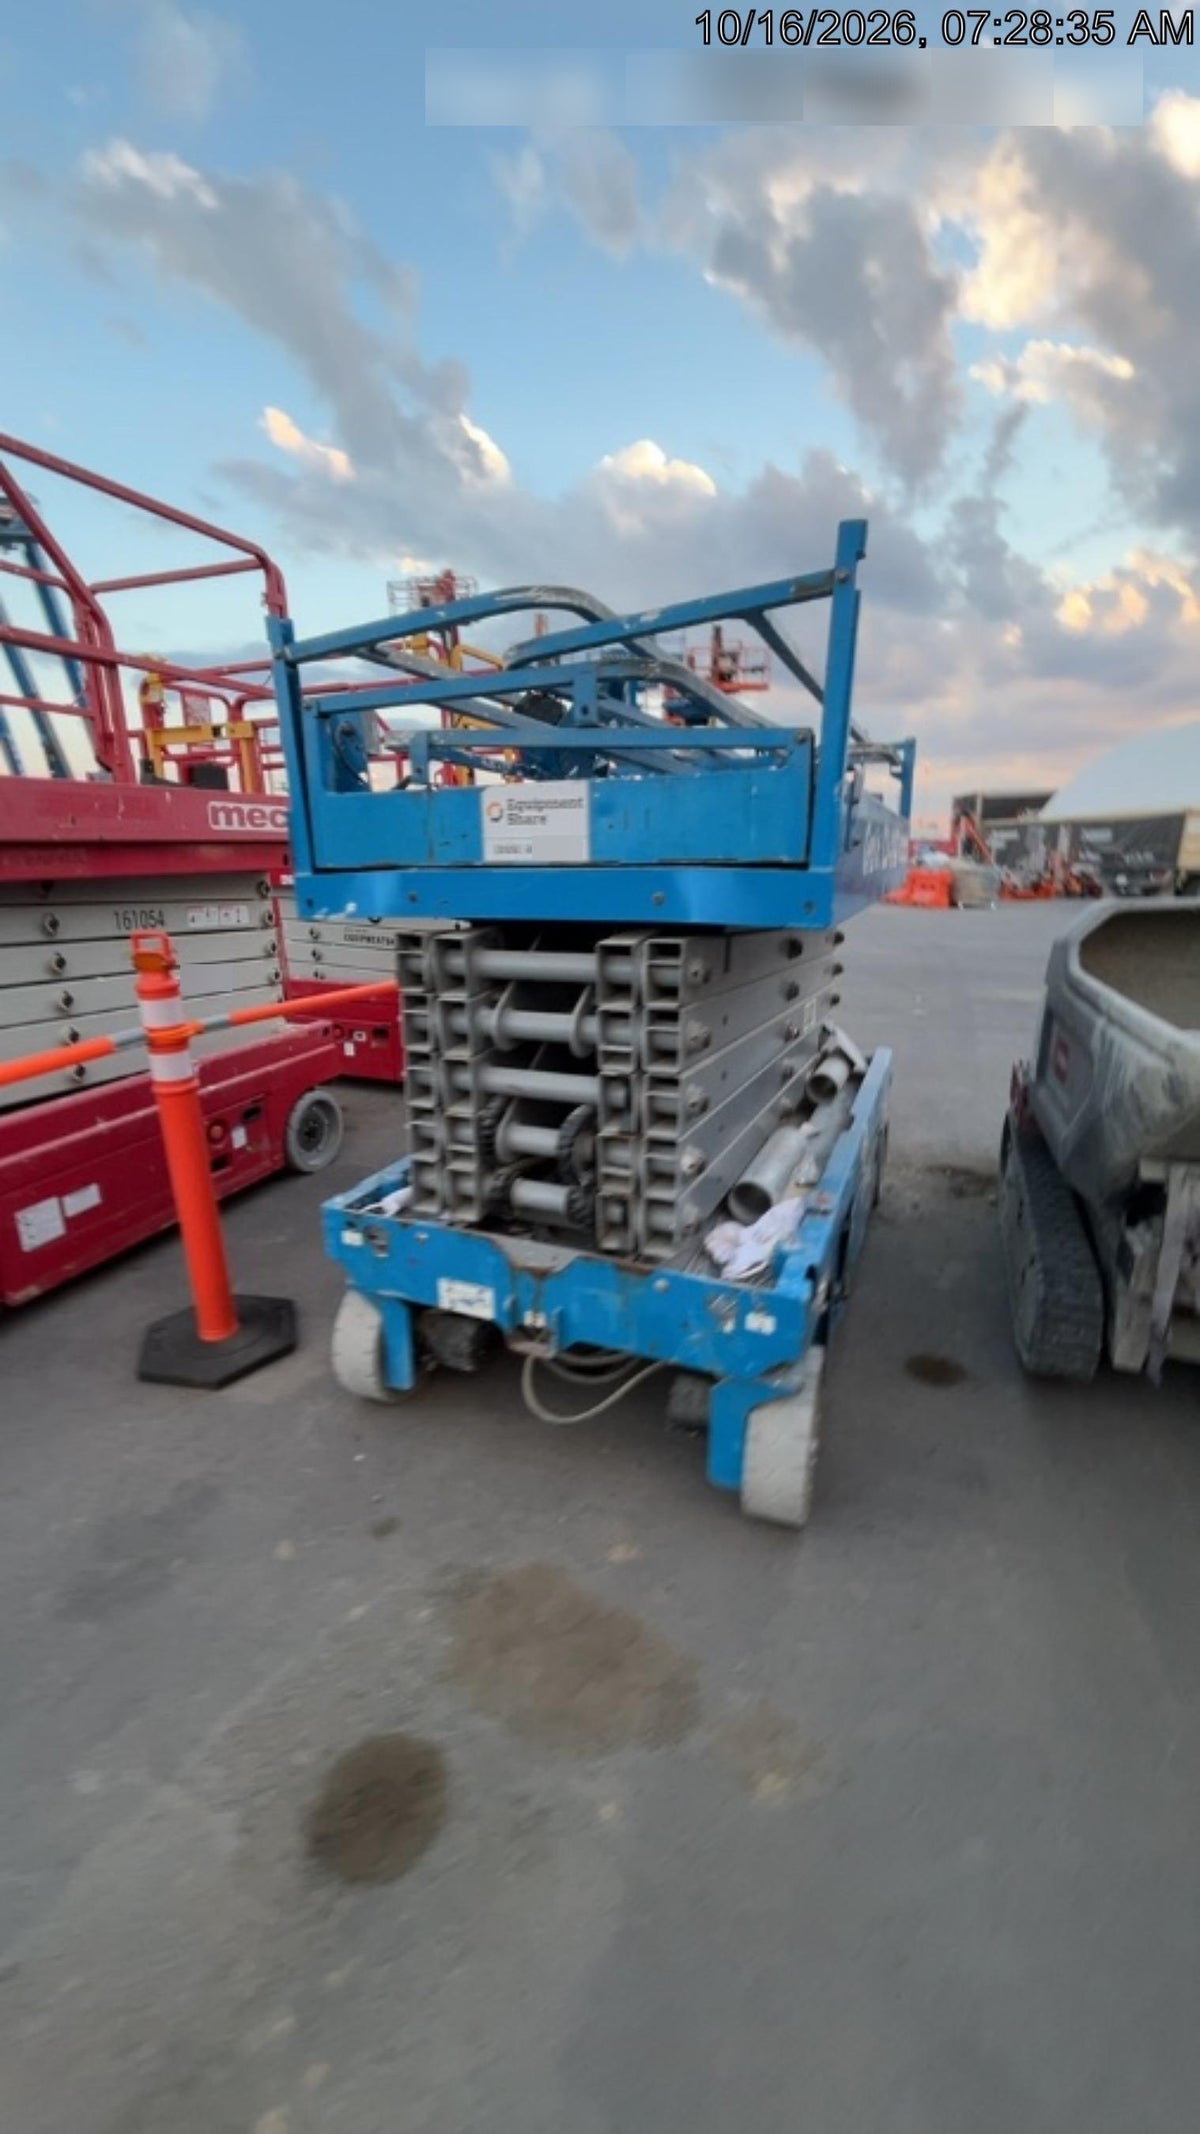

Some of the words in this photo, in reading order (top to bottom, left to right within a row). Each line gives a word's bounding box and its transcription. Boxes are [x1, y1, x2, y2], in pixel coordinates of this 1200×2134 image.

[506, 798, 584, 812] Equipment
[210, 805, 288, 828] mec
[506, 813, 547, 826] Share
